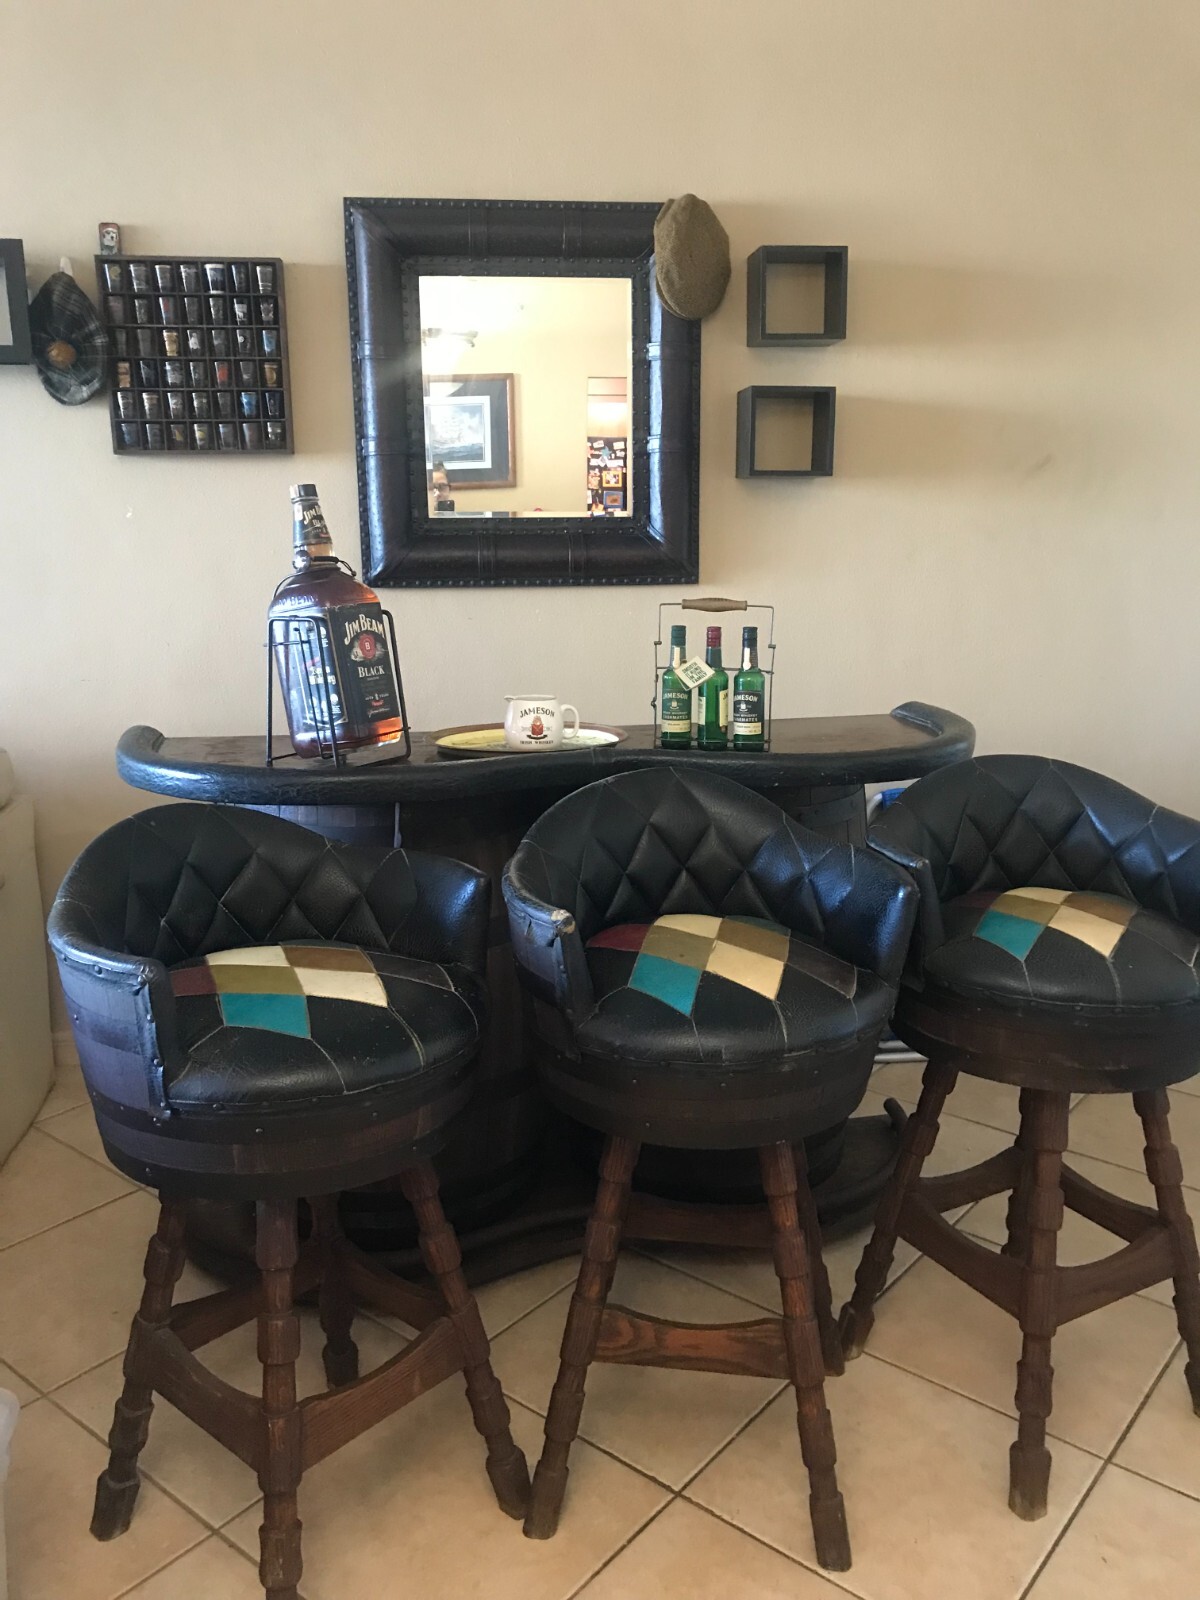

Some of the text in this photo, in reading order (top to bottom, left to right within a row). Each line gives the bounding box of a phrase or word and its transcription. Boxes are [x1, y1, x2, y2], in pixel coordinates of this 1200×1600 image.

[344, 613, 386, 645] JIM BEAM
[357, 665, 386, 678] BLACK
[520, 706, 555, 718] JAMESON
